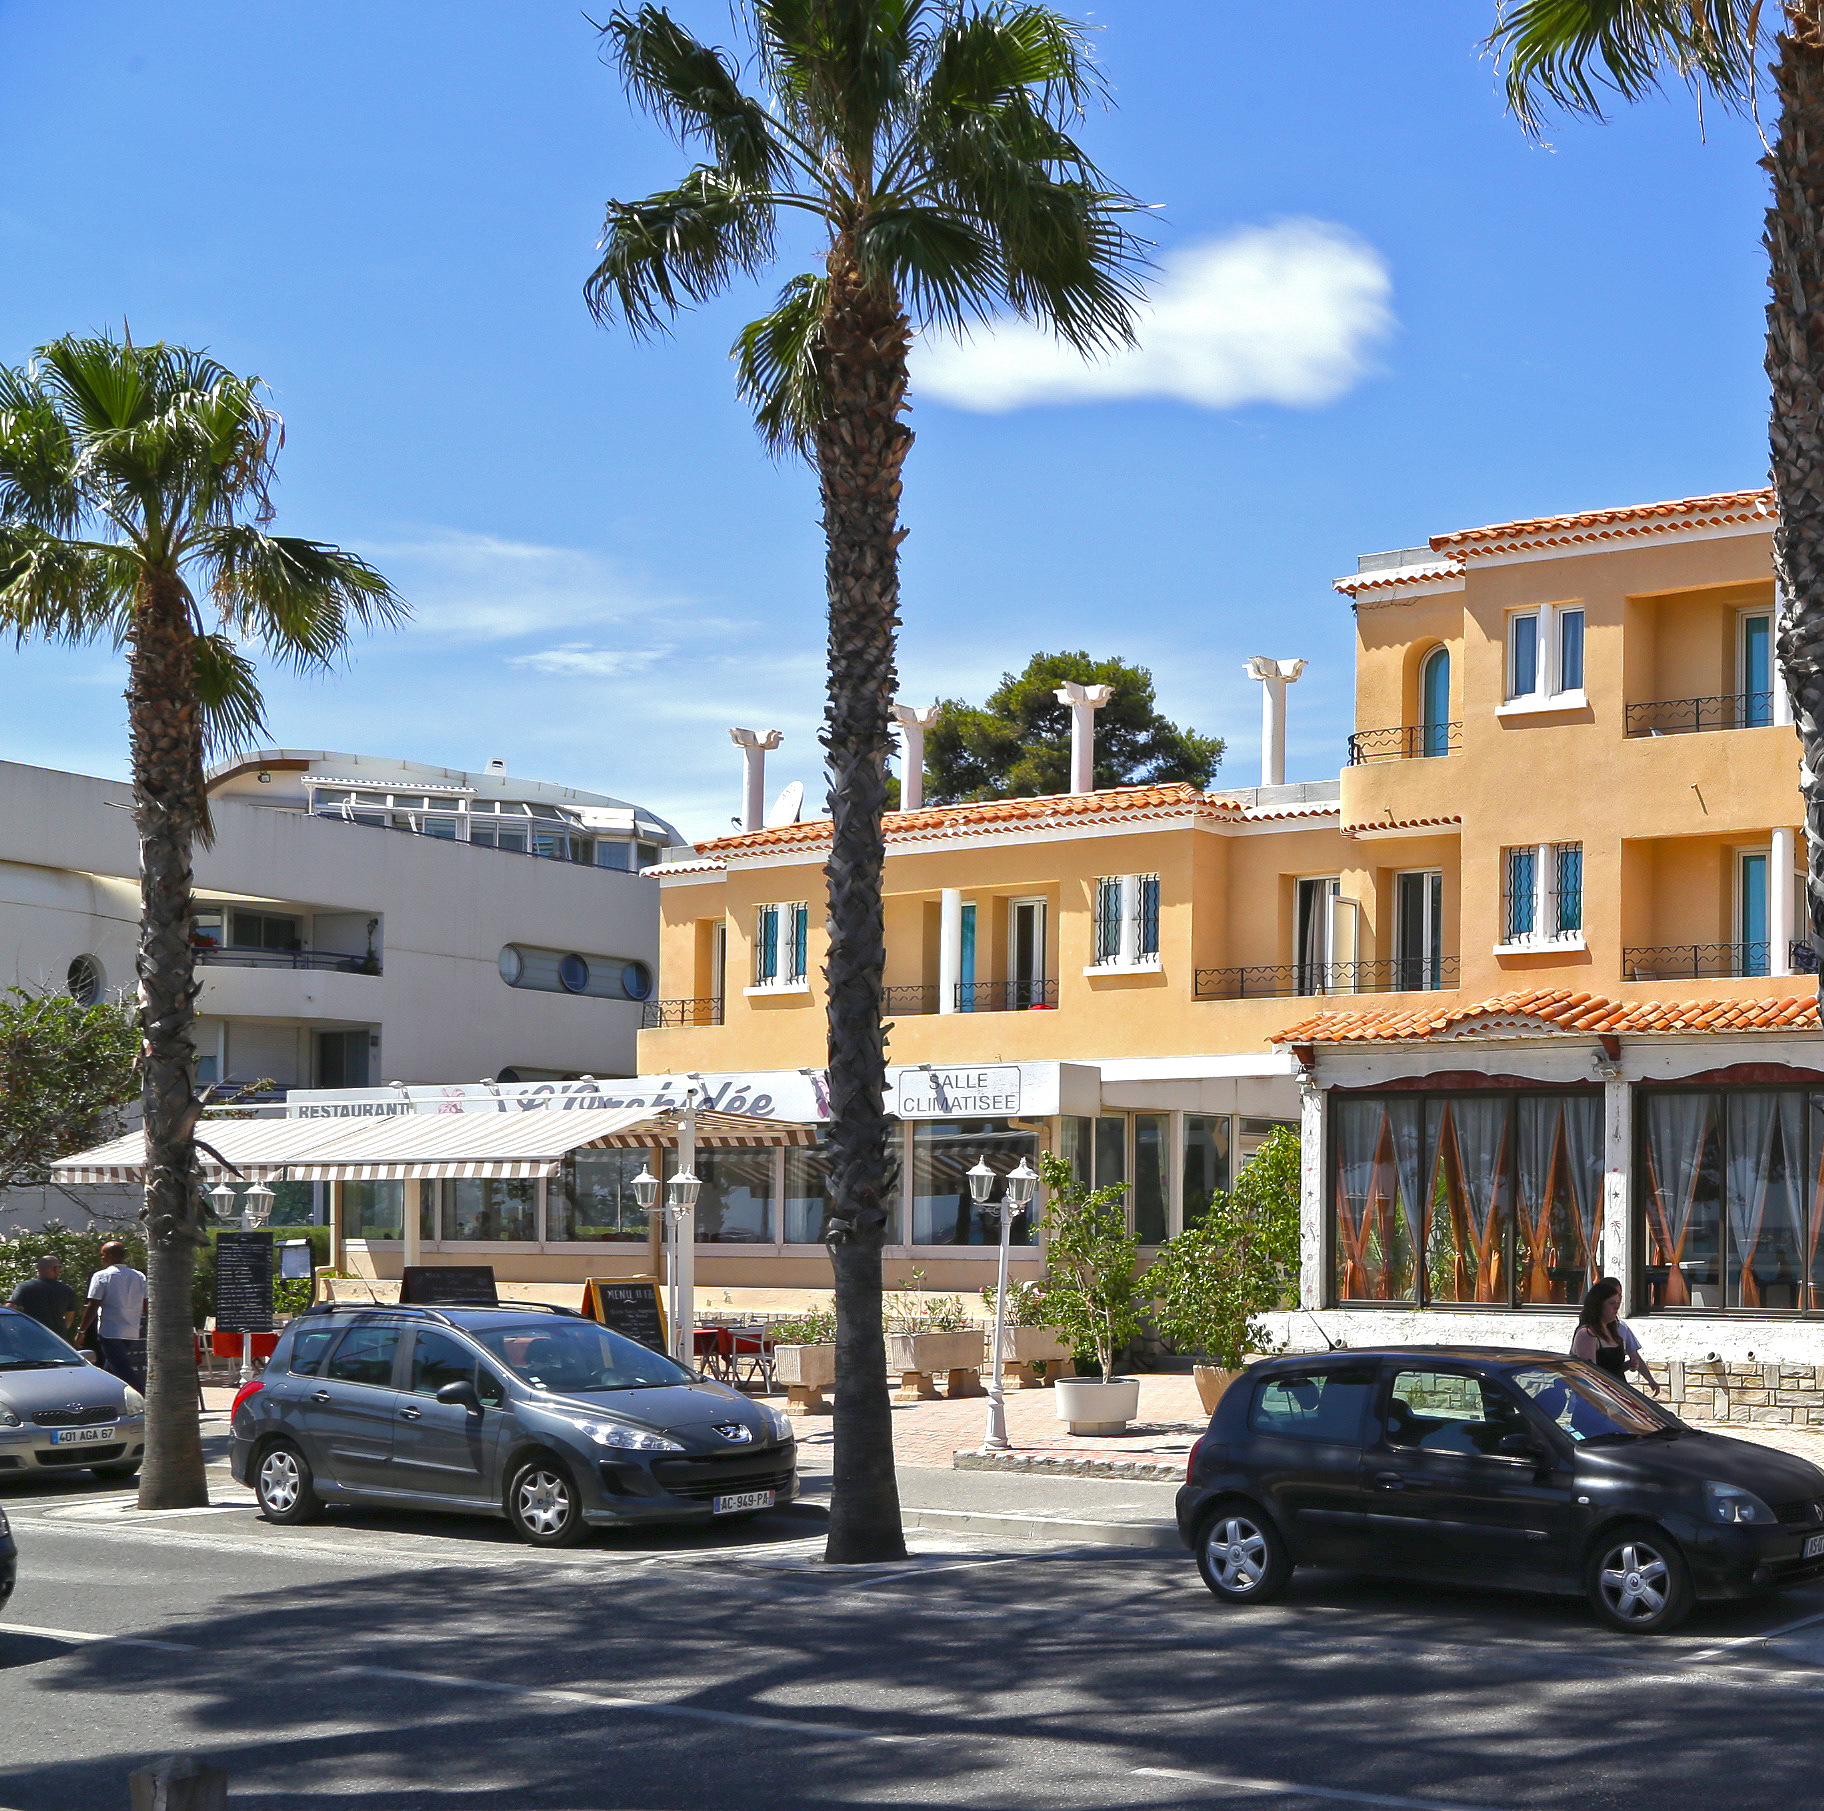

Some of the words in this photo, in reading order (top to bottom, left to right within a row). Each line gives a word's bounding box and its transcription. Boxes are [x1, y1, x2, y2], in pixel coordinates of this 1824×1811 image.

[929, 1073, 988, 1090] SALLE
[903, 1095, 1016, 1112] CLIMATISEE
[607, 1289, 634, 1300] MENU
[59, 1431, 77, 1442] 401
[79, 1429, 98, 1441] AGA
[101, 1428, 114, 1439] 67
[721, 1492, 768, 1511] AC-949-PA
